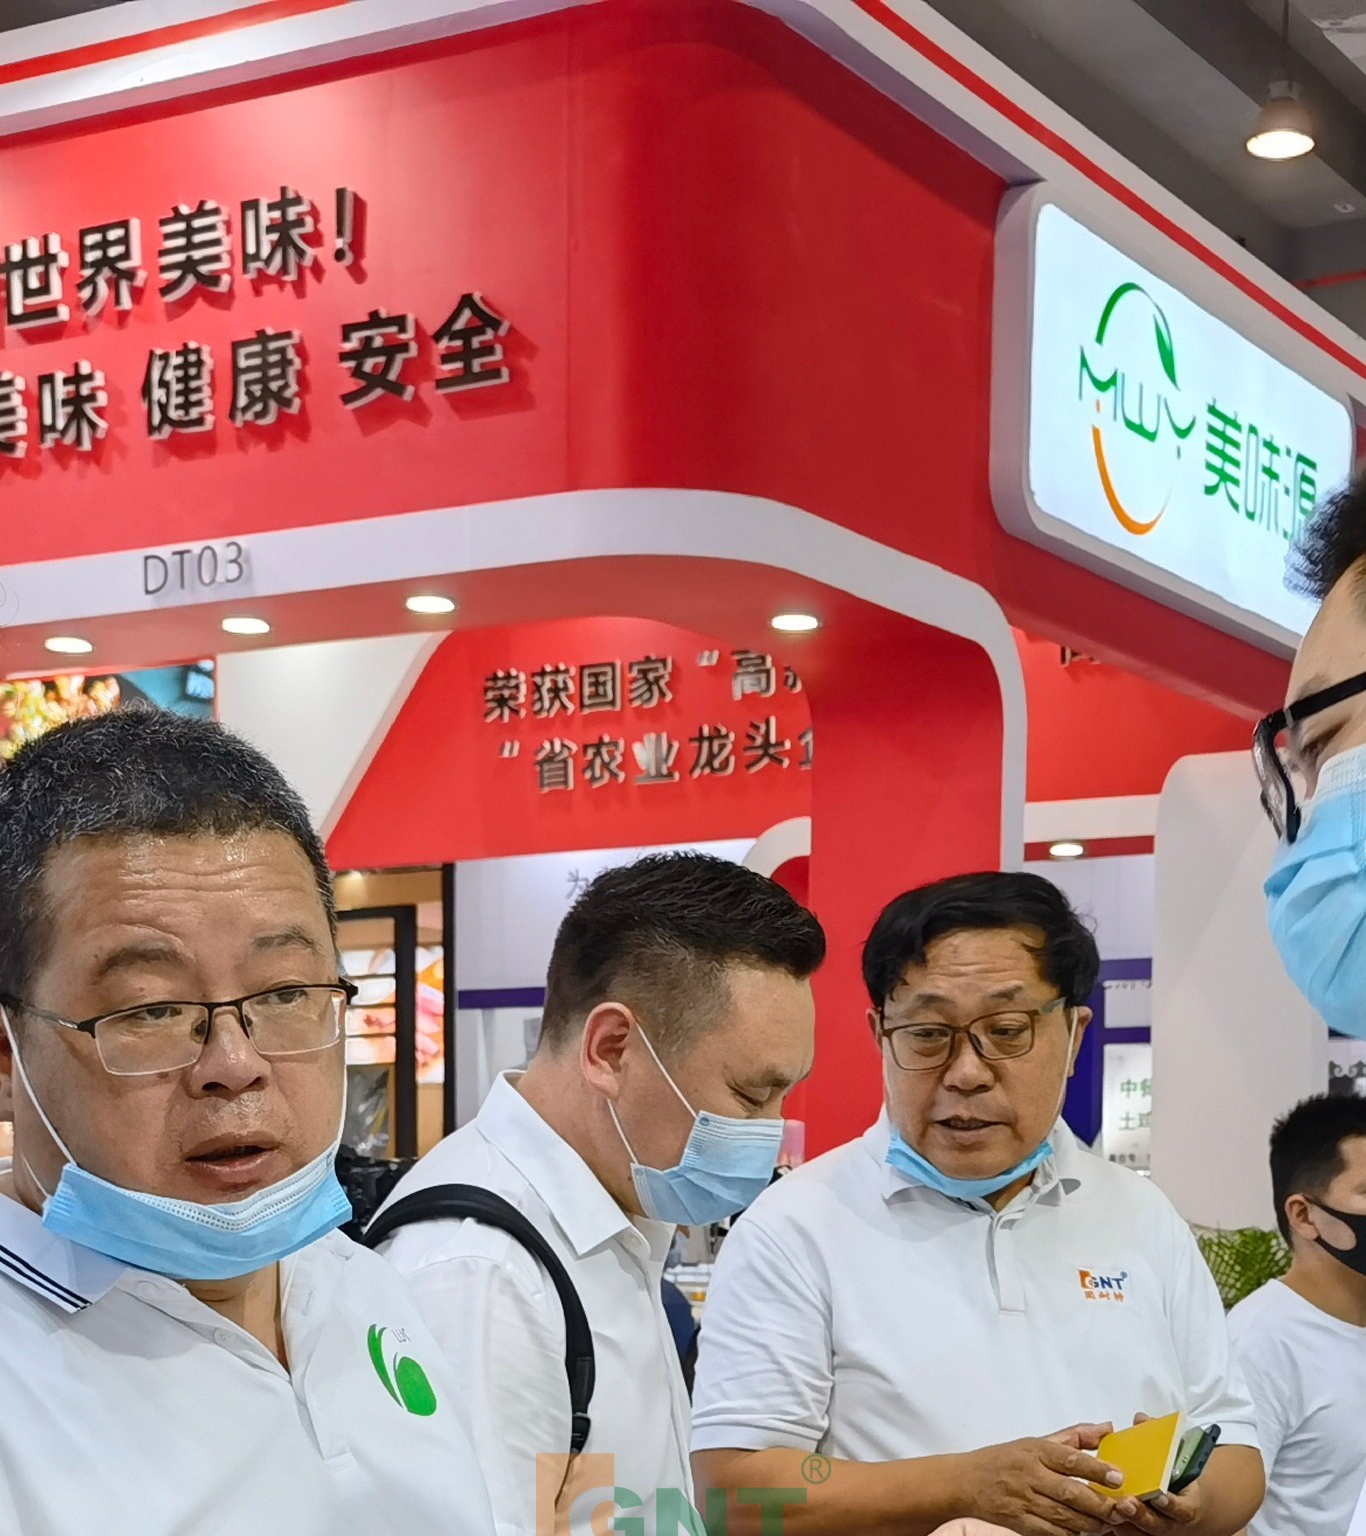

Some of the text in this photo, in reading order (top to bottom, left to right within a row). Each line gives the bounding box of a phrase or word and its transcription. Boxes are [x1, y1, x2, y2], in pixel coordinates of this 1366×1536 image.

[142, 326, 303, 444] 健康
[339, 290, 512, 406] 安全
[142, 539, 249, 597] DT03
